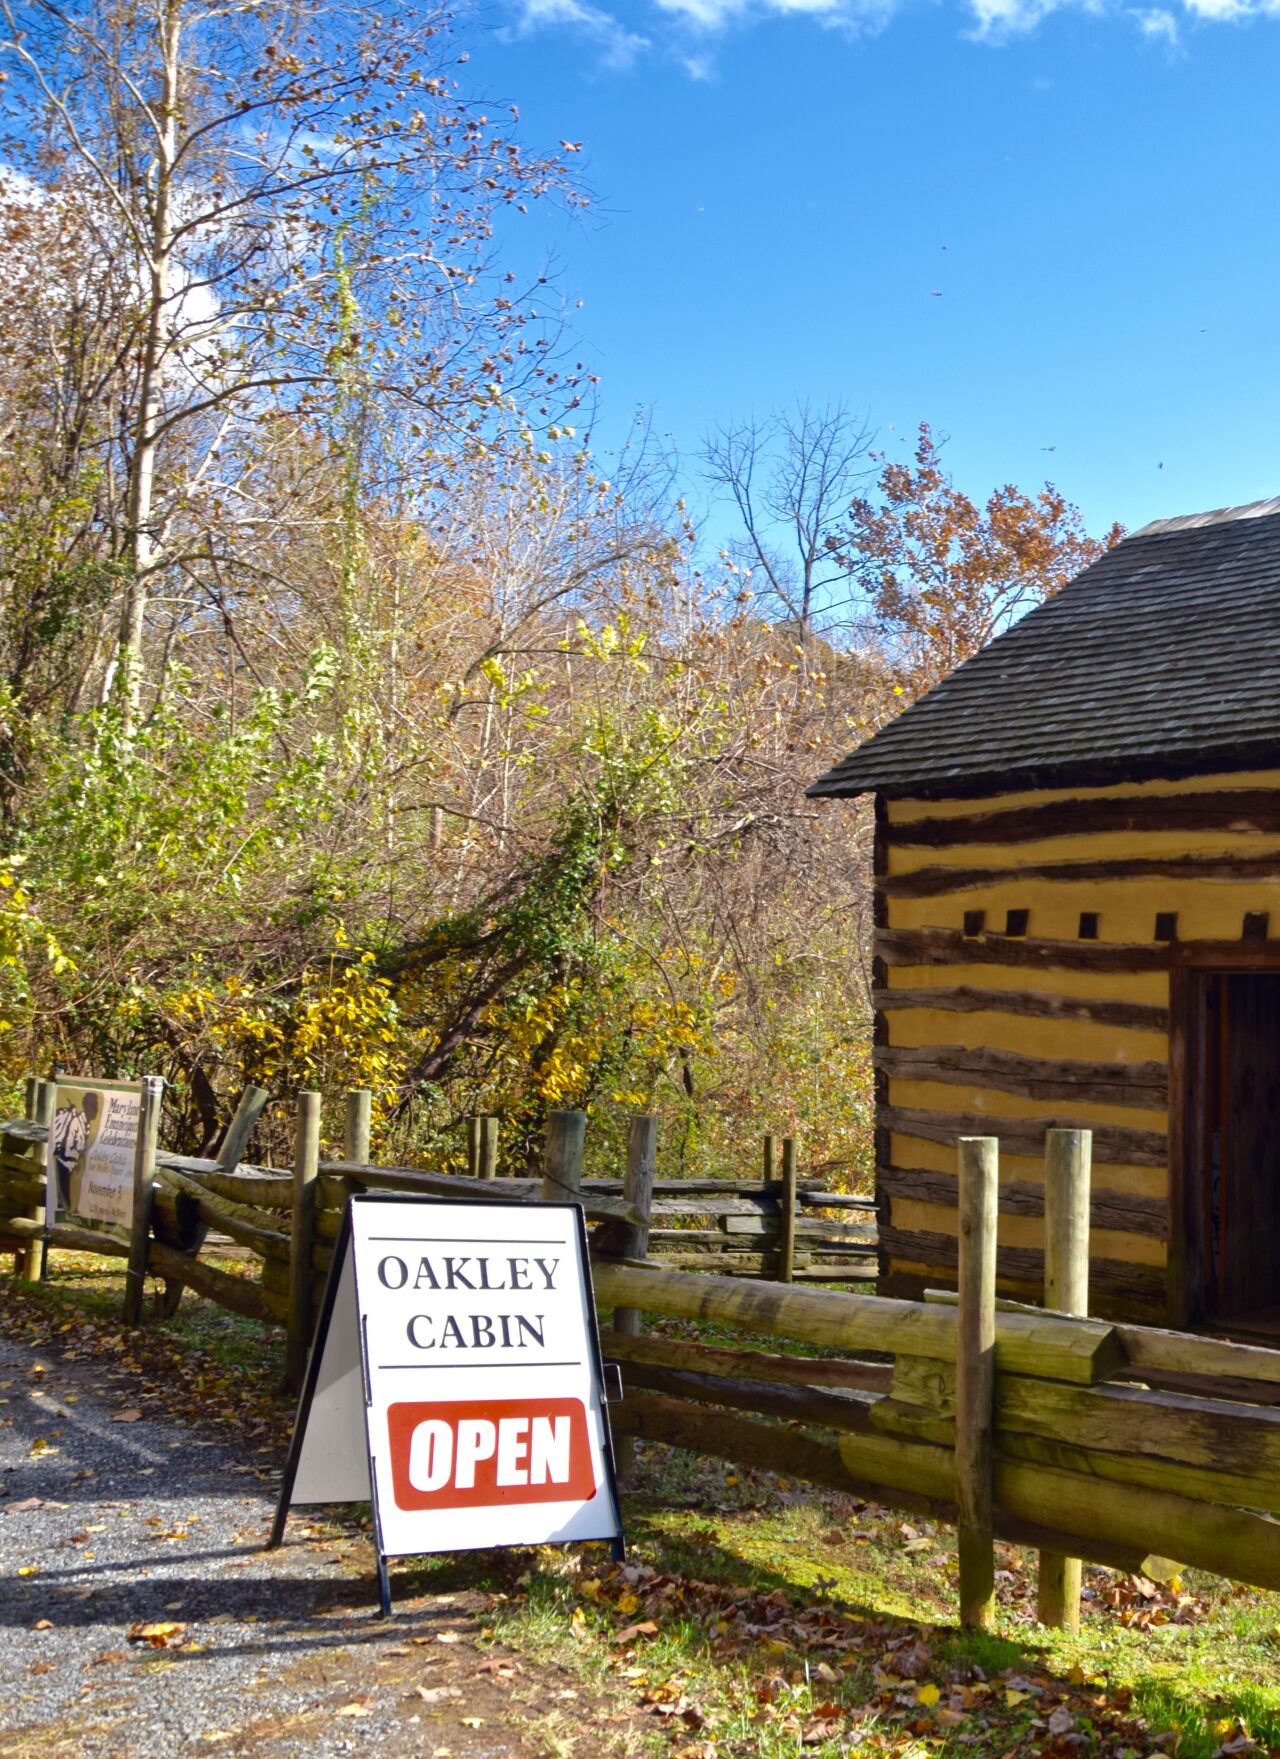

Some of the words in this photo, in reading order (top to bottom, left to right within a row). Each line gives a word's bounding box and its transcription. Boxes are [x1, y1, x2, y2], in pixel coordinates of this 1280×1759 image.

[377, 1255, 560, 1290] OAKLEY
[406, 1314, 545, 1349] CABIN
[408, 1416, 571, 1492] OPEN
